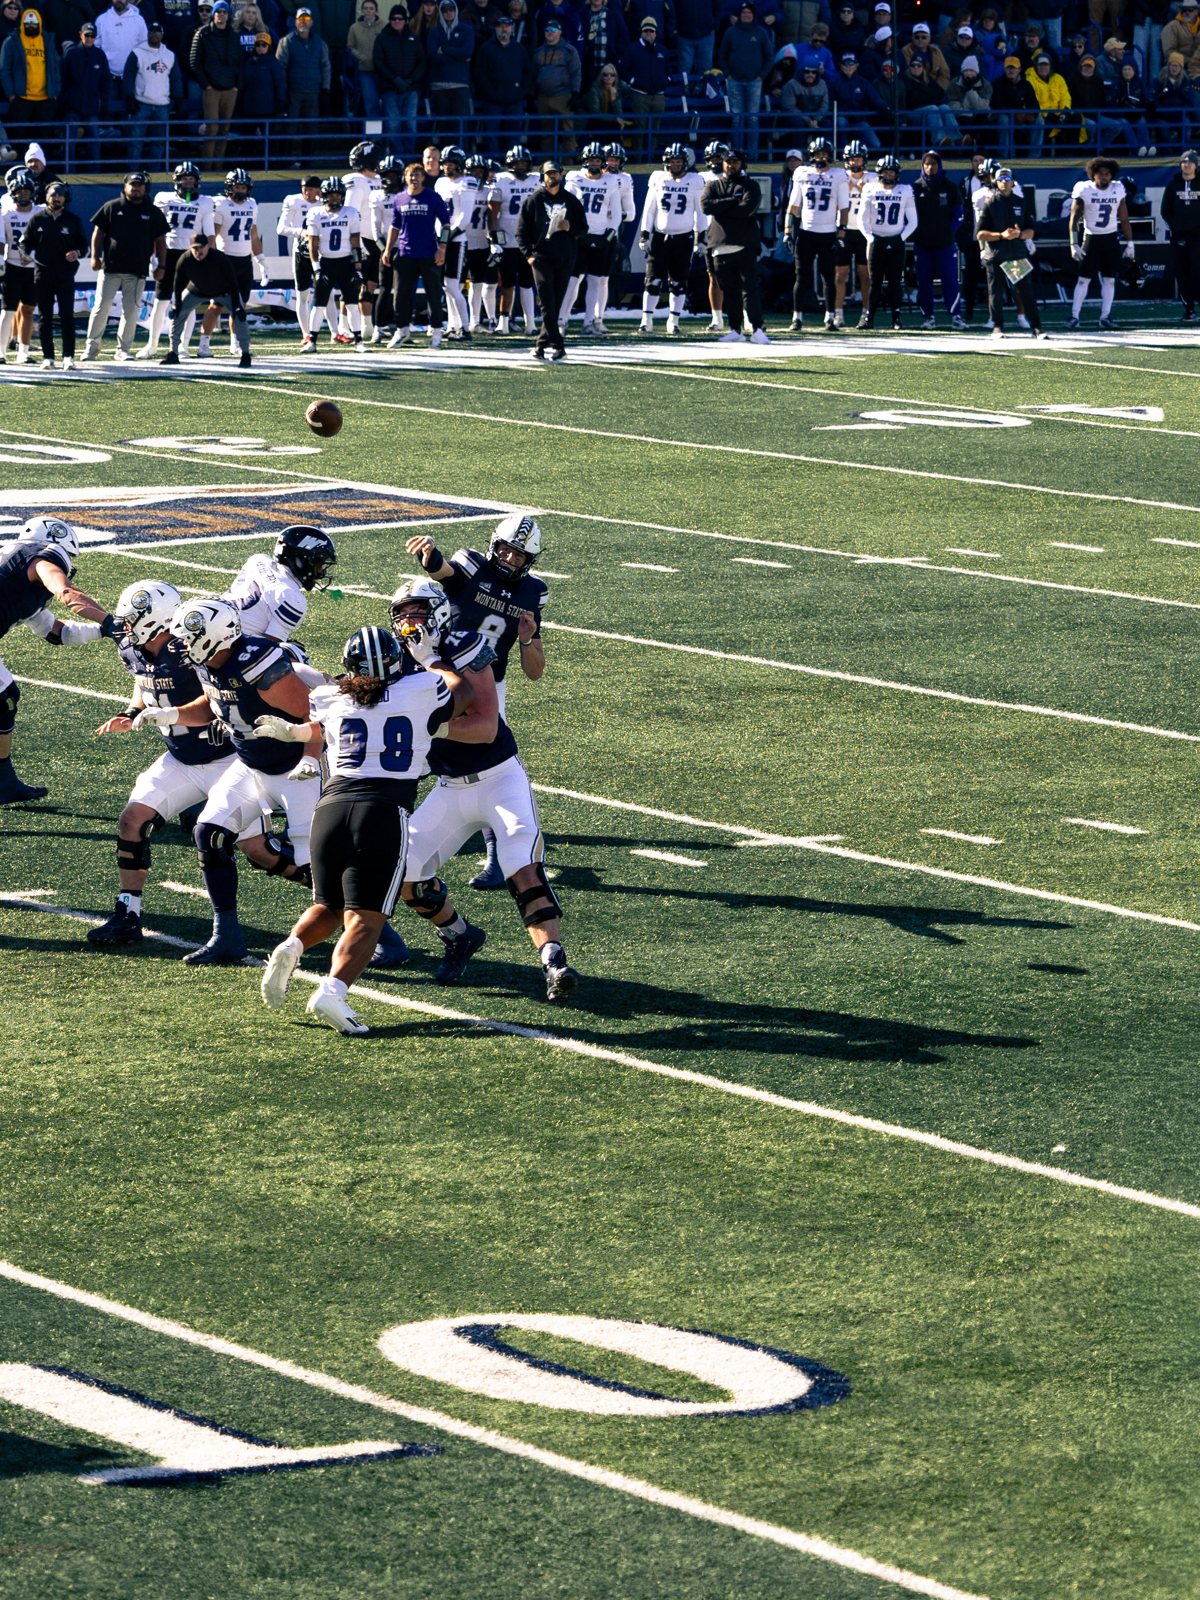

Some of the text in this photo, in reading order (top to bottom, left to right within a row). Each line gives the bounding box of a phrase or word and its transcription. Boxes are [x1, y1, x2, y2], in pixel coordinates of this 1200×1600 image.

[580, 186, 607, 194] WILDCATS
[168, 205, 199, 214] WILDCATS
[581, 193, 605, 214] 16
[660, 193, 688, 215] 53
[321, 220, 349, 229] WILDCATS
[1095, 204, 1113, 228] 3
[328, 228, 342, 252] 0
[473, 591, 506, 613] MONTANA
[155, 677, 176, 690] STATE
